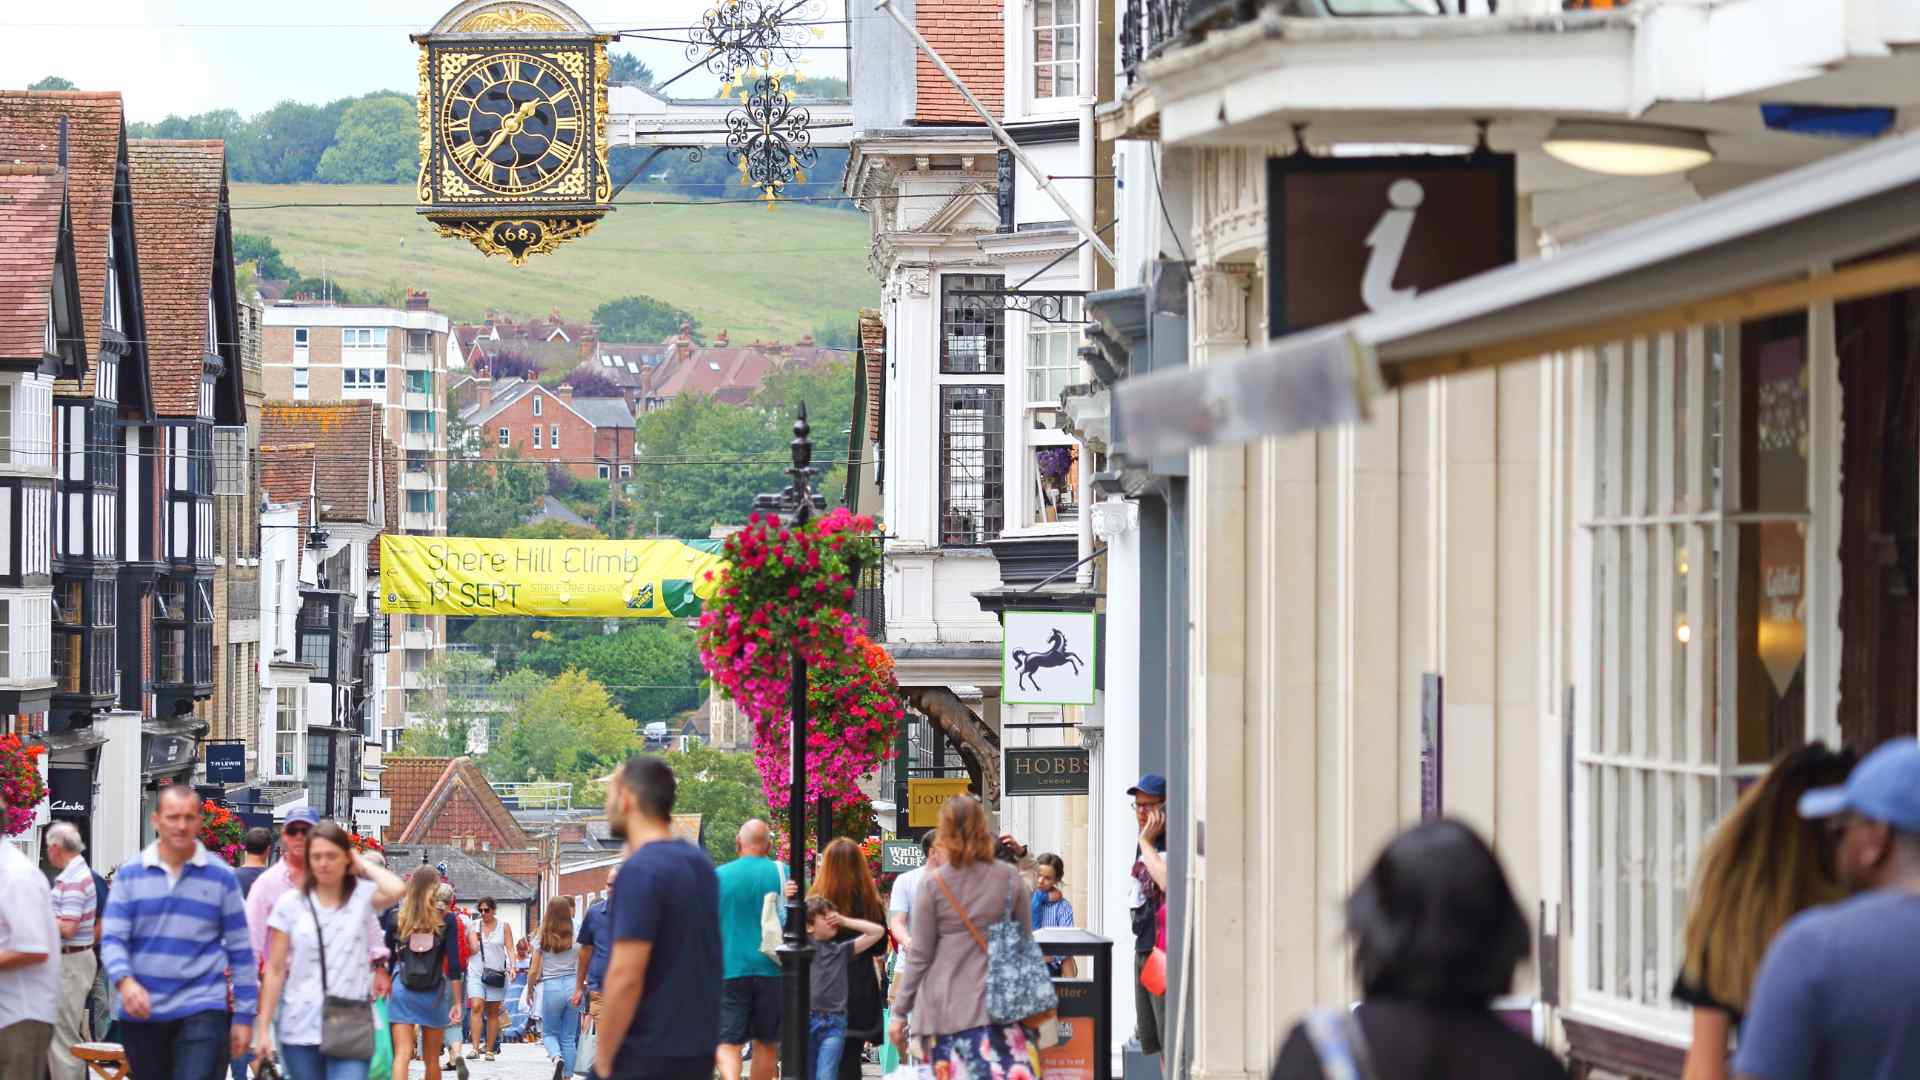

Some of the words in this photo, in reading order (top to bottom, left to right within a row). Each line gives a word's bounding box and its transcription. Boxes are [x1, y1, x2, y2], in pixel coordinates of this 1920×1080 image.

[427, 542, 505, 573] Shere
[515, 545, 553, 573] Hill
[563, 545, 640, 574] Climb
[427, 579, 453, 607] 1ST
[460, 582, 521, 609] SEPT
[1015, 757, 1089, 774] HOBBS
[50, 800, 85, 811] Clarks
